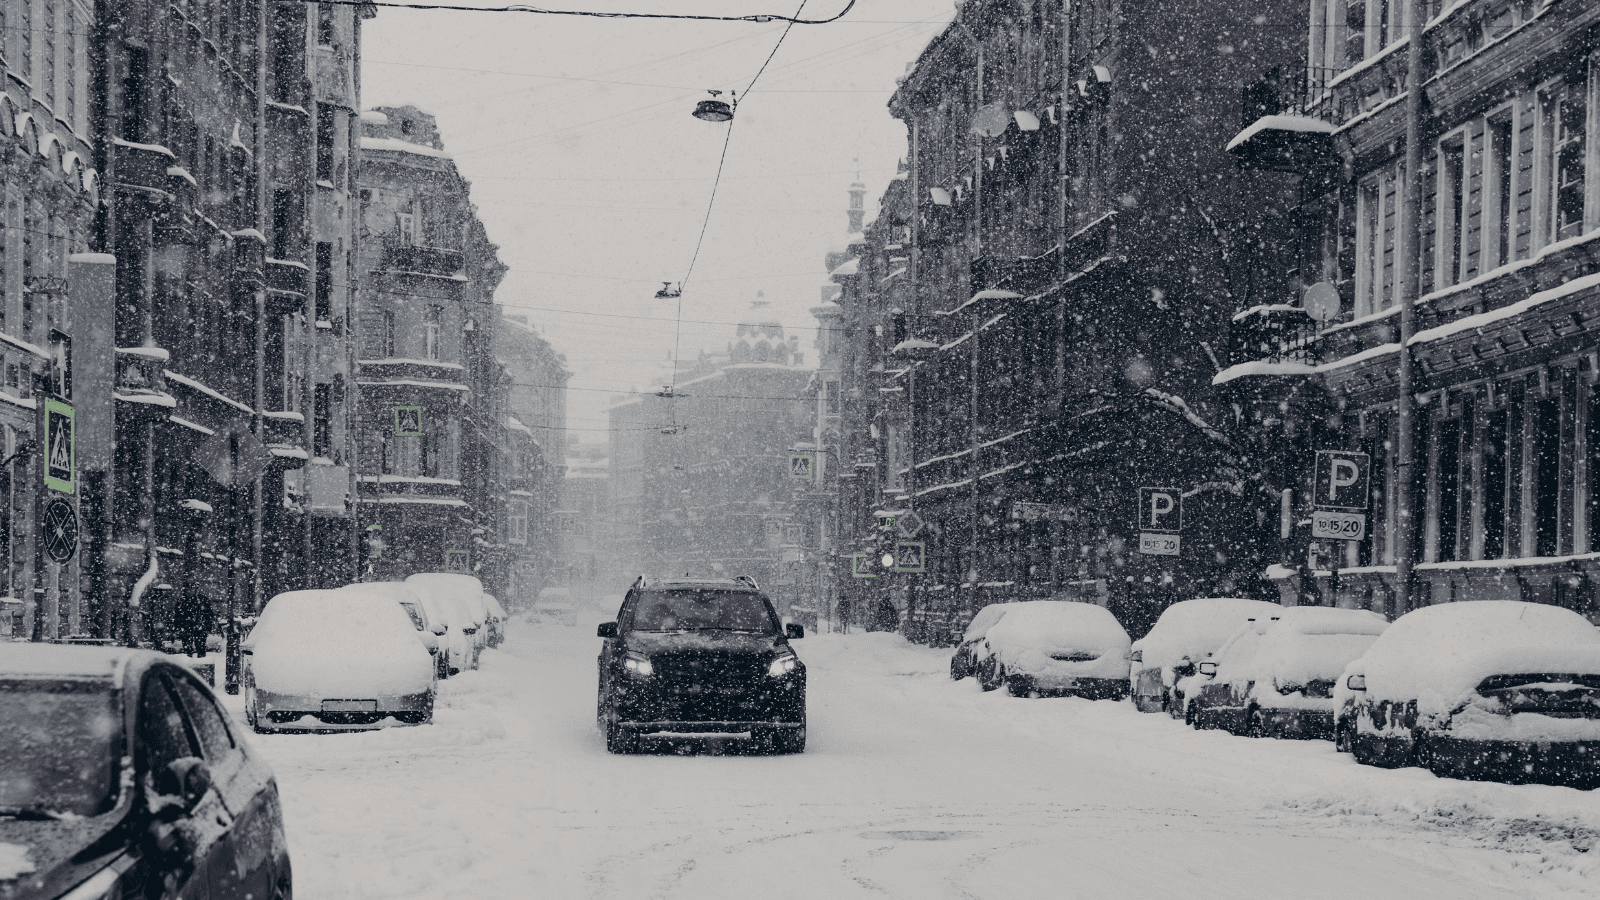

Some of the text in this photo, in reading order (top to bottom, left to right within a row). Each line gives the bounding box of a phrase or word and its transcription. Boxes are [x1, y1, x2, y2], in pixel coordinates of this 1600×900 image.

[1329, 459, 1359, 501] P
[1151, 493, 1174, 525] P
[1319, 520, 1359, 532] 10 15 20
[1164, 540, 1176, 549] 20
